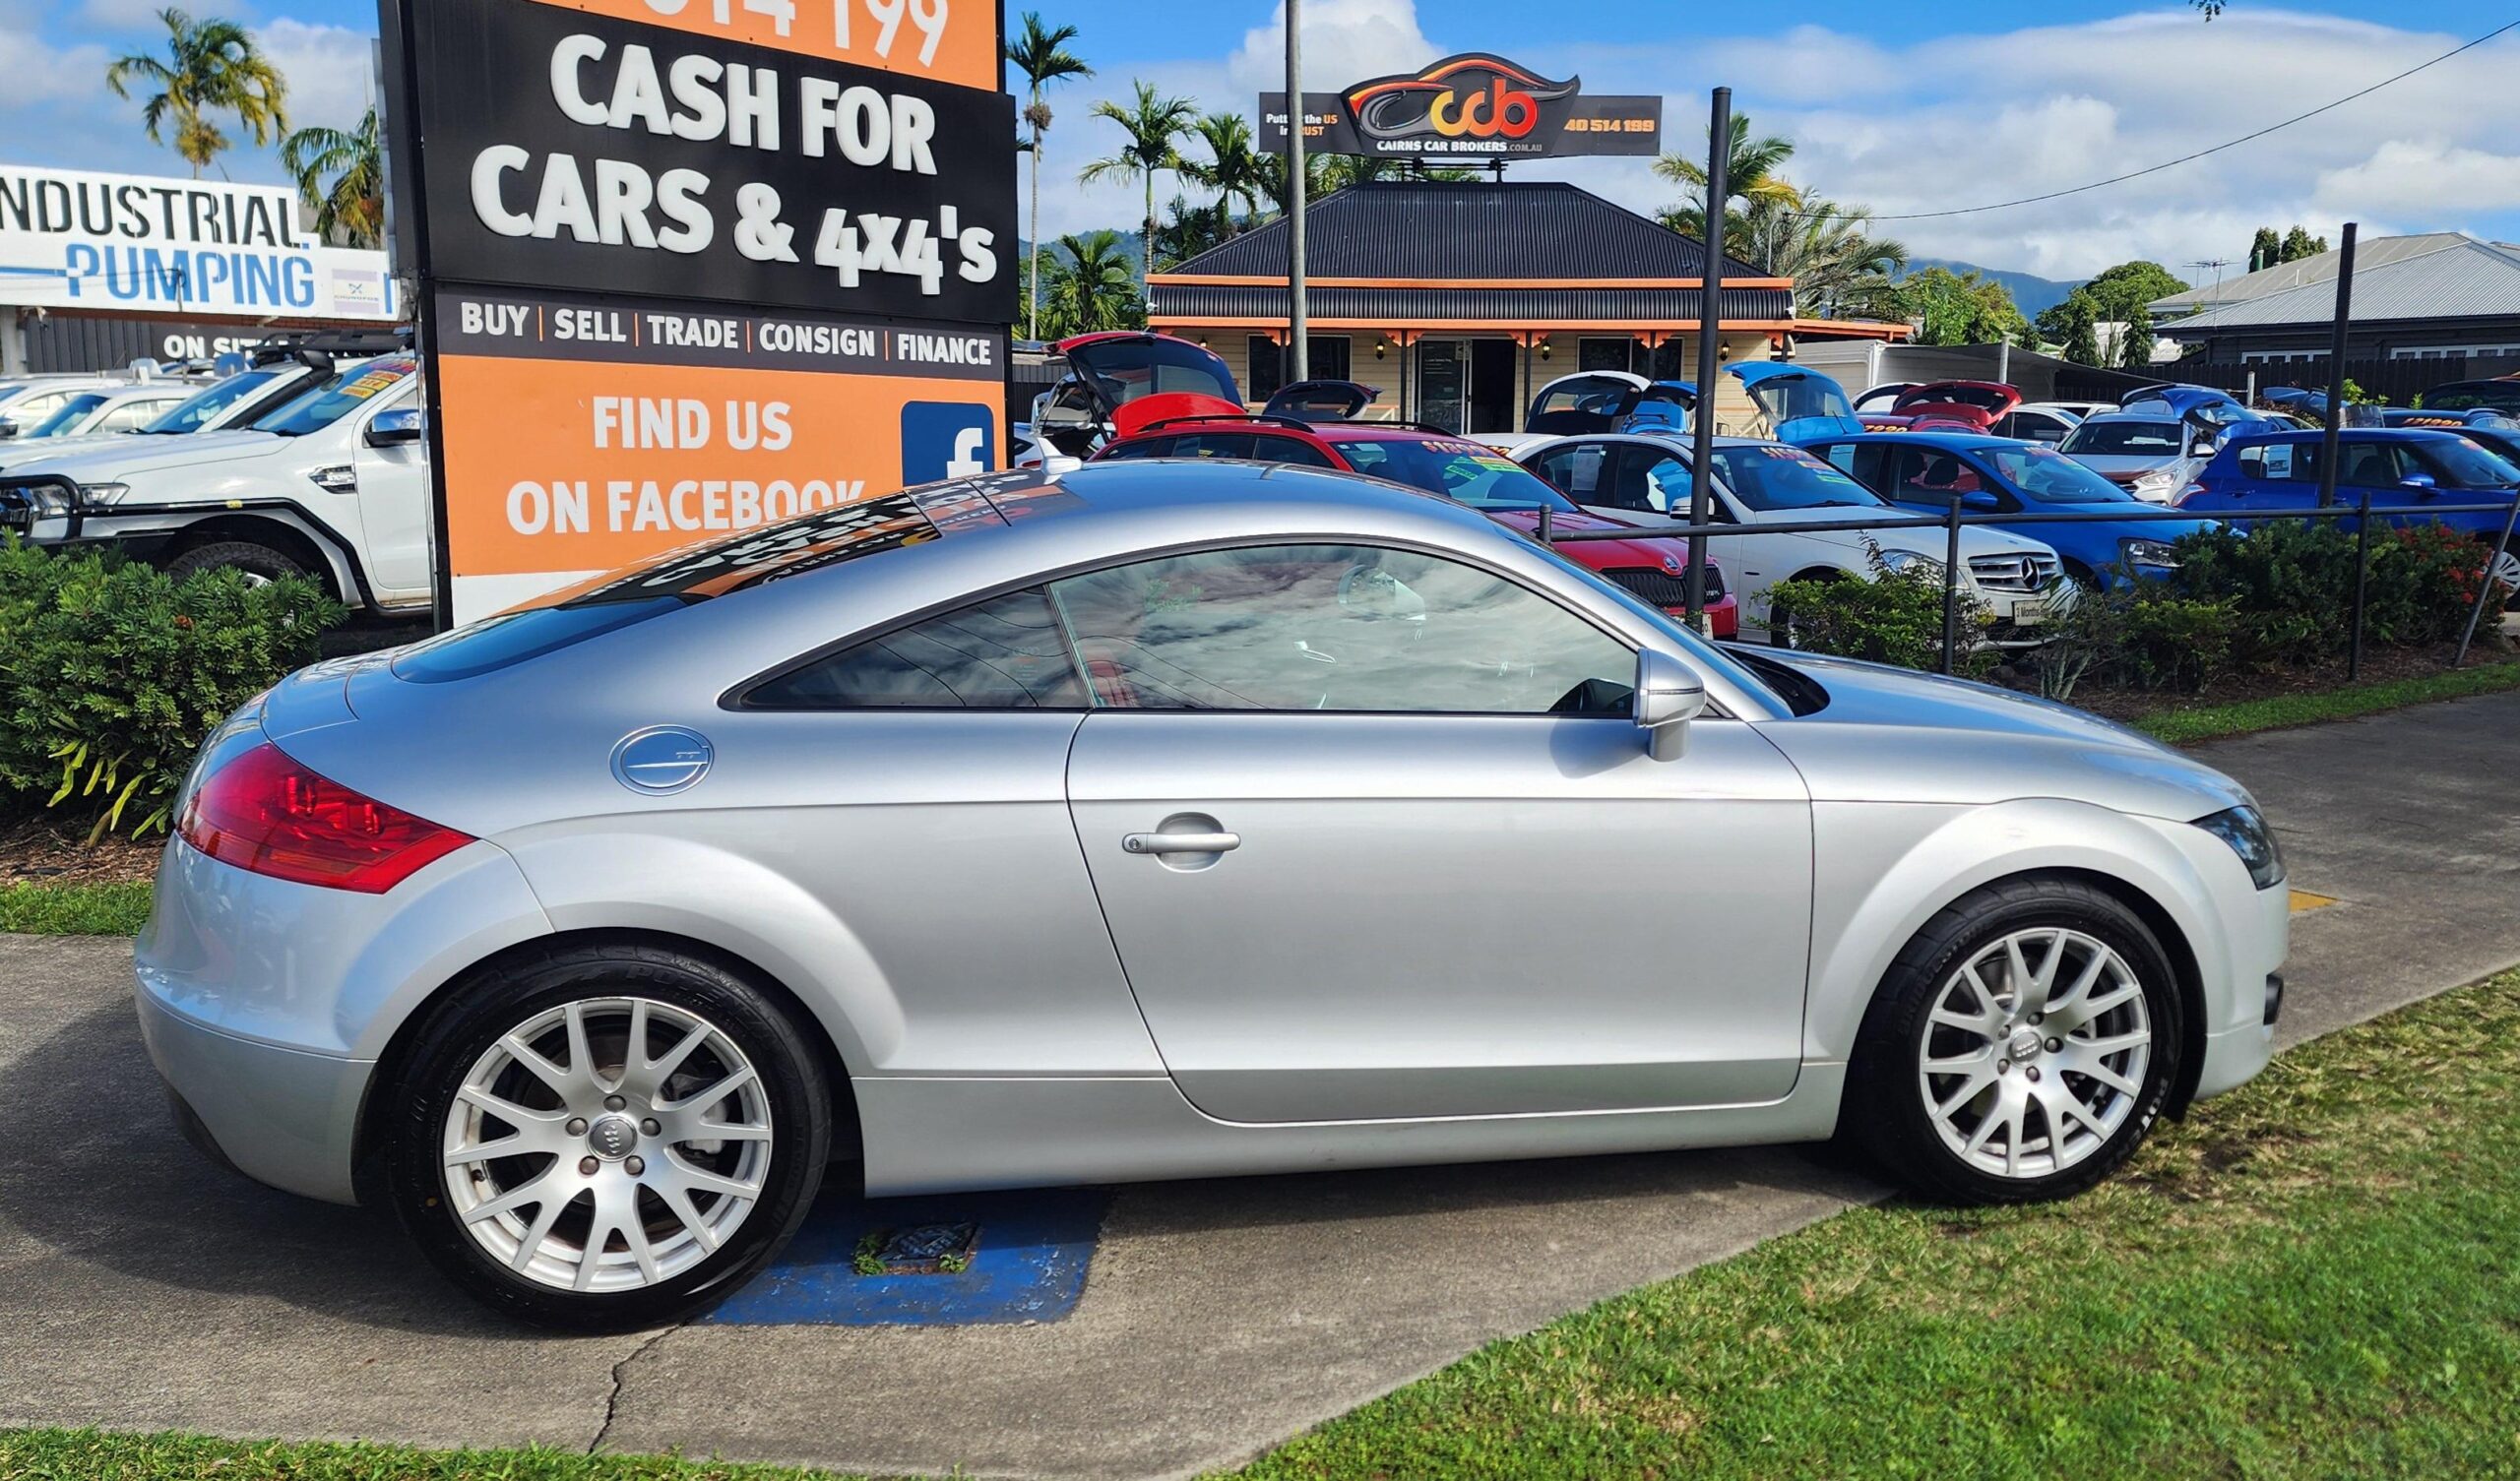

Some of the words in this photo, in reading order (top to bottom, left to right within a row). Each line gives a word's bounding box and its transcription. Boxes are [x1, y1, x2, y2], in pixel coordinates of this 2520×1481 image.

[550, 33, 780, 152] CASH
[801, 77, 937, 175] FOR
[1304, 114, 1322, 124] the
[1323, 114, 1339, 124] US
[1563, 119, 1589, 132] 40
[1590, 119, 1621, 132] 514
[1623, 119, 1655, 133] 199
[1376, 141, 1421, 152] CAIRNS
[1423, 141, 1448, 152] CAR
[471, 145, 714, 254] CARS
[733, 182, 800, 263] &
[66, 243, 314, 308] PUMPING
[163, 335, 205, 359] ON
[461, 302, 530, 337] BUY
[554, 309, 627, 344] SELL
[647, 315, 738, 349] TRADE
[759, 324, 875, 358] CONSIGN
[898, 334, 992, 367] FINANCE
[594, 396, 711, 450] FIND
[726, 401, 792, 452] US
[506, 481, 590, 535] ON
